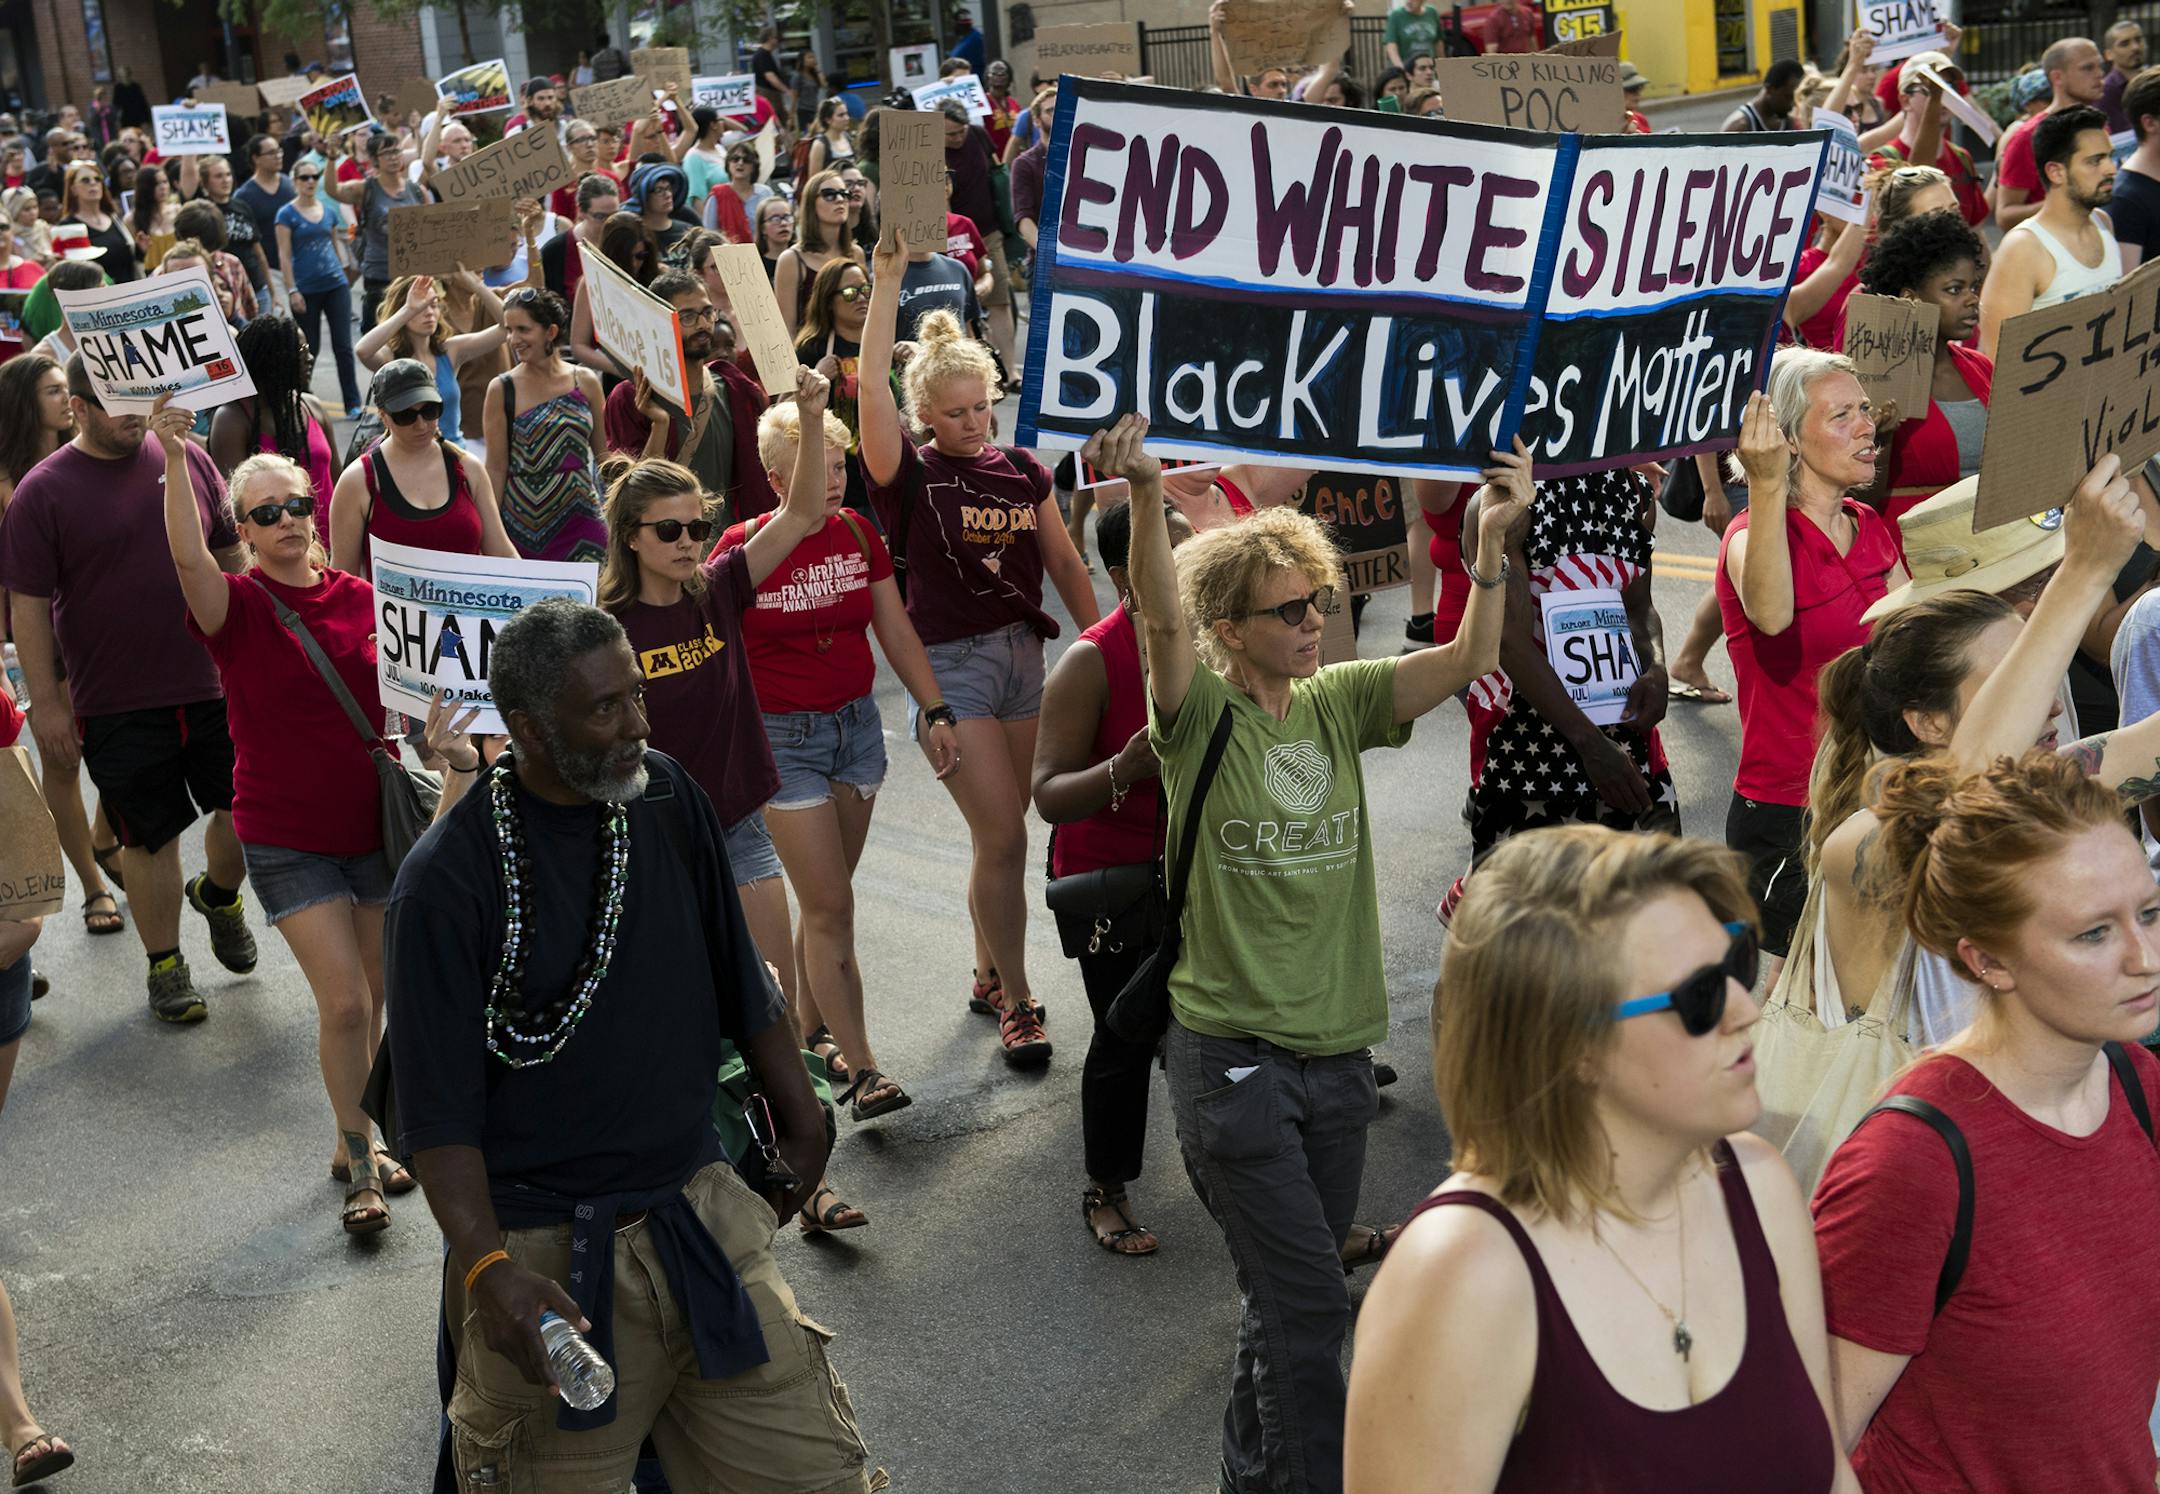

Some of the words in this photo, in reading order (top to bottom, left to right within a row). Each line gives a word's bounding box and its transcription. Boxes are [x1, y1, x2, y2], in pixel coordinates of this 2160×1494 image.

[1472, 61, 1520, 80] STOP
[1532, 62, 1616, 84] KILLING
[699, 87, 750, 106] SHAME
[1500, 86, 1580, 132] POC
[162, 119, 222, 140] SHAME
[886, 122, 933, 150] WHITE
[450, 125, 548, 198] JUSTICE
[891, 154, 945, 187] SILENCE
[905, 194, 915, 214] IS
[1059, 121, 1230, 263] END
[1250, 120, 1540, 292] WHITE
[1561, 162, 1812, 299] SILENCE
[914, 283, 961, 295] BOEING
[89, 304, 164, 329] Minnesota
[80, 313, 221, 381] SHAME
[652, 329, 676, 388] is
[1040, 290, 1353, 440] Black
[1357, 316, 1582, 458] Lives
[1591, 308, 1753, 458] Matter
[960, 506, 1008, 531] FOOD
[409, 577, 524, 609] Minnesota
[1218, 863, 1238, 874] FROM
[1241, 868, 1266, 877] PUBLIC
[1284, 869, 1301, 878] SAINT
[1302, 866, 1318, 875] PAUL
